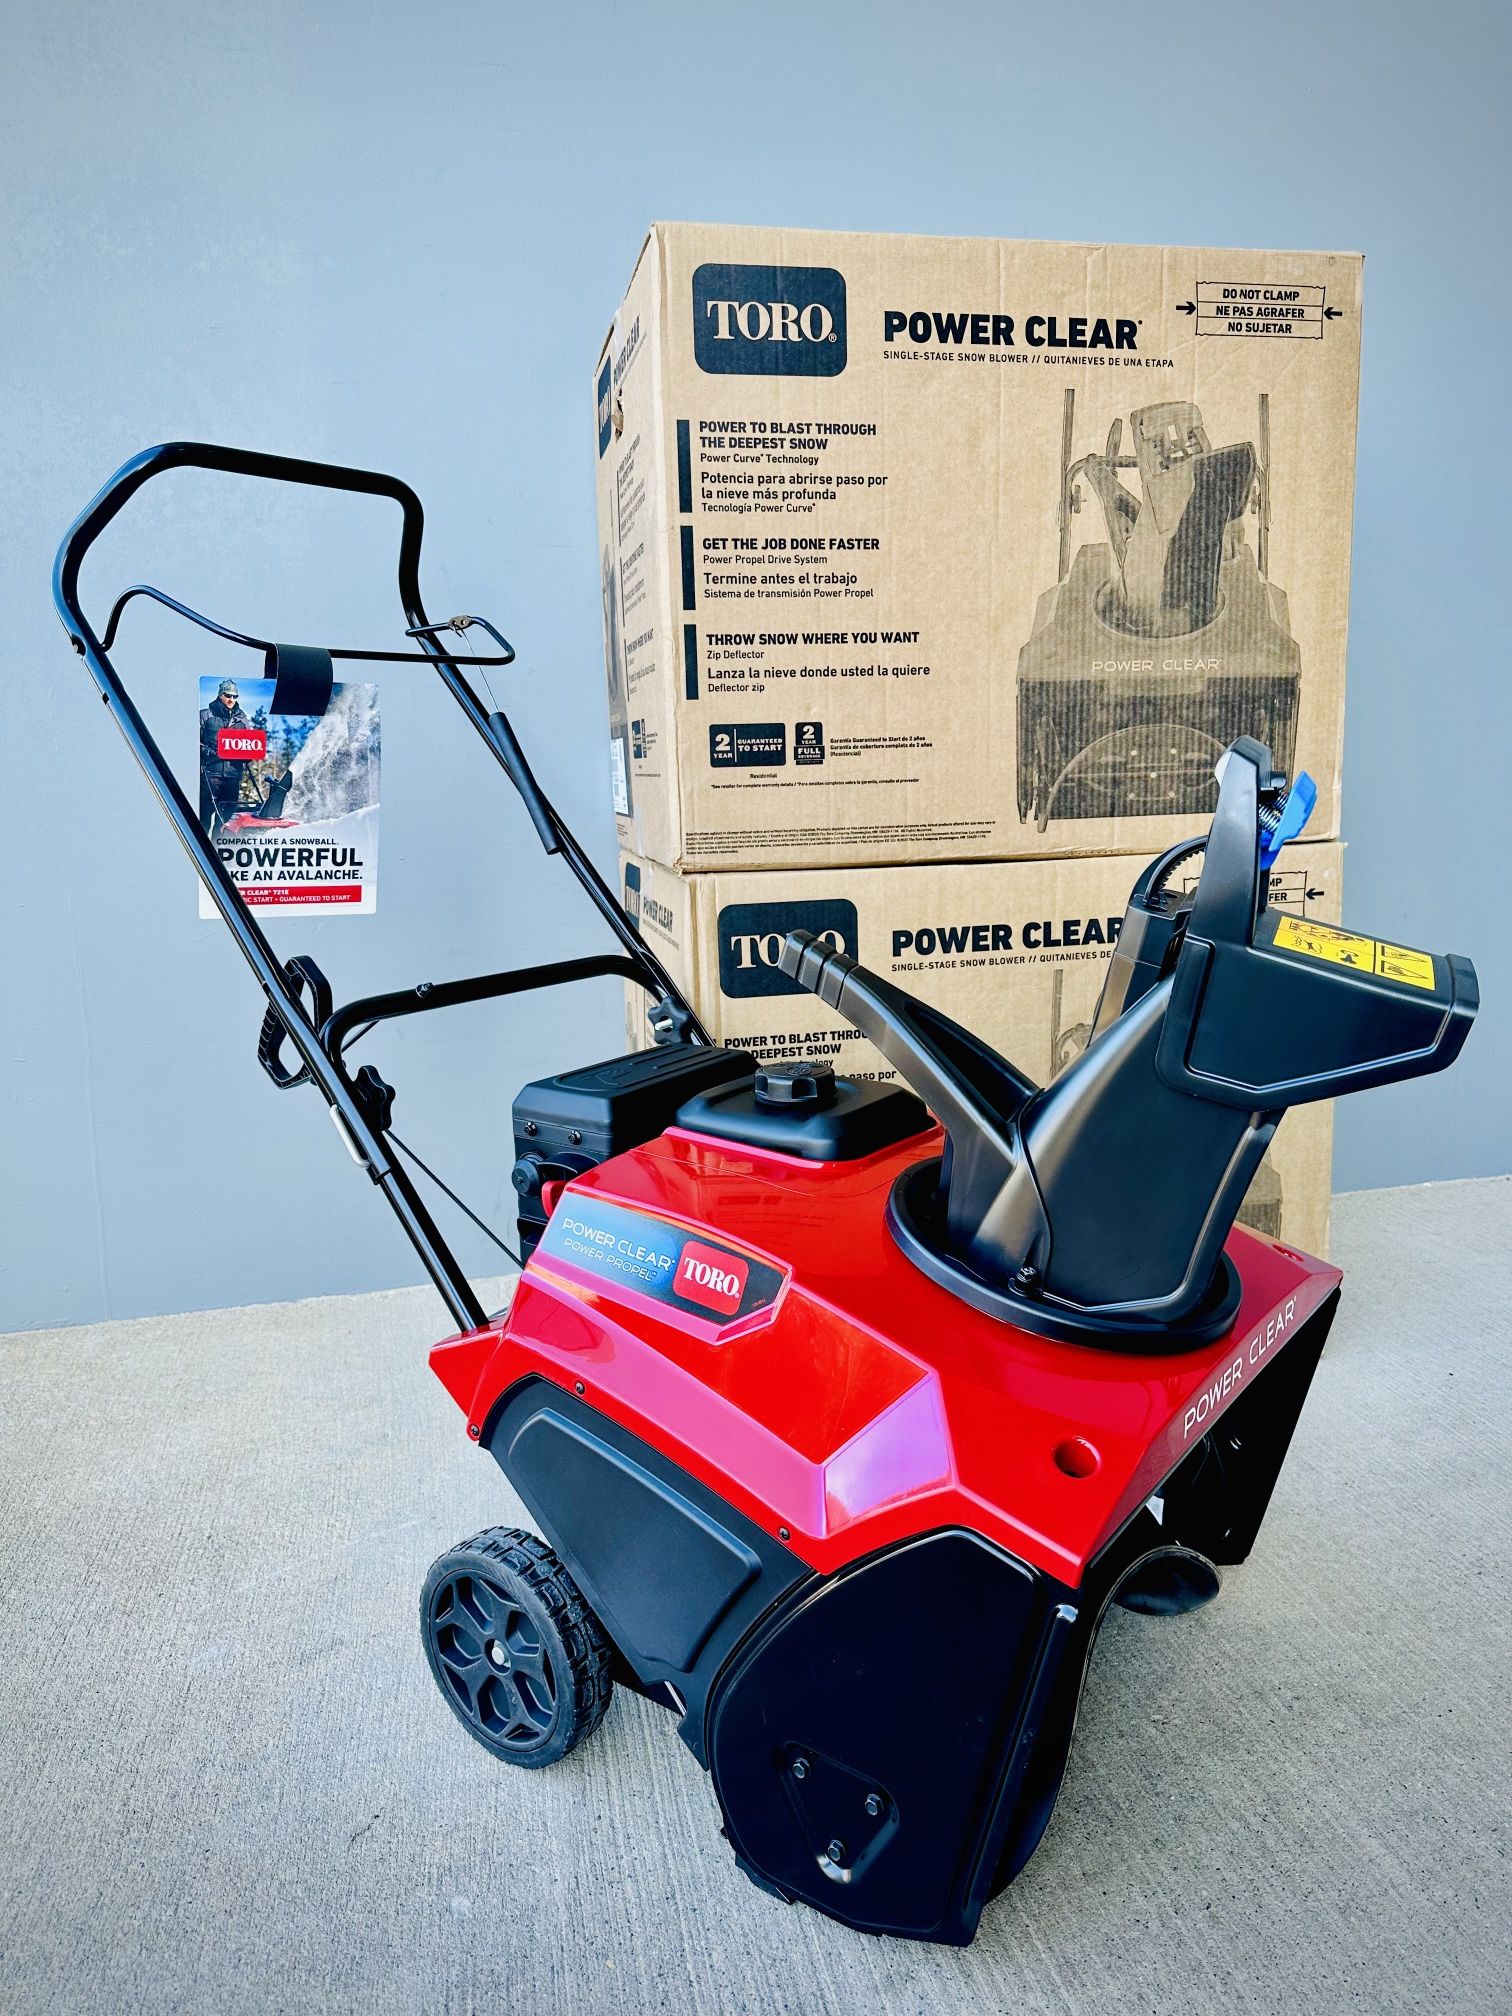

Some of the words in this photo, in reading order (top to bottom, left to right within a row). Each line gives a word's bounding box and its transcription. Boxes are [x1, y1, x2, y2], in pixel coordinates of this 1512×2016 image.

[1222, 288, 1237, 300] DO
[1239, 288, 1261, 301] NOT
[1263, 289, 1300, 302] CLAMP
[1216, 306, 1231, 317] NE
[1232, 306, 1253, 318] PAS
[1256, 306, 1305, 319] AGRAFER
[883, 310, 1015, 346] POWER
[1227, 321, 1242, 333] NO
[1244, 322, 1293, 334] SUJETAR
[883, 350, 953, 362] SINGLE-STAGE
[958, 353, 986, 363] SNOW
[989, 354, 1028, 364] BLOWER
[1043, 355, 1105, 367] QUITANIEVES
[1108, 357, 1120, 367] DE
[1123, 357, 1142, 367] UNA
[1145, 358, 1174, 368] ETAPA
[699, 420, 747, 433] POWER
[750, 421, 767, 433] TO
[770, 422, 812, 434] BLAST
[815, 423, 877, 436] THROUGH
[700, 437, 725, 448] THE
[729, 437, 786, 449] DEEPEST
[789, 438, 828, 449] SNOW
[700, 454, 731, 463] Power
[765, 454, 819, 466] Technology
[701, 472, 754, 484] Potencia
[757, 474, 785, 487] para
[788, 473, 833, 485] abrirse
[836, 475, 865, 488] paso
[867, 476, 888, 488] por
[701, 488, 713, 499] la
[716, 489, 749, 499] nieve
[752, 487, 778, 500] más
[782, 489, 836, 501] profunda
[702, 502, 752, 514] Tecnología
[754, 503, 784, 513] Power
[702, 538, 728, 550] GET
[731, 538, 758, 549] THE
[761, 538, 787, 549] JOB
[790, 538, 826, 550] DONE
[829, 538, 880, 550] FASTER
[703, 554, 733, 564] Power
[735, 554, 765, 566] Propel
[768, 554, 792, 564] Drive
[794, 555, 828, 566] System
[704, 572, 757, 584] Termine
[761, 573, 795, 584] antes
[798, 572, 810, 584] el
[813, 572, 858, 587] trabajo
[704, 589, 741, 598] Sistema
[744, 589, 755, 598] de
[757, 588, 811, 598] transmisión
[814, 588, 842, 598] Power
[845, 588, 874, 599] Propel
[707, 634, 755, 645] THROW
[758, 633, 798, 645] SNOW
[802, 633, 848, 644] WHERE
[851, 632, 878, 644] YOU
[881, 631, 920, 643] WANT
[707, 650, 721, 660] Zip
[723, 650, 765, 659] Deflector
[707, 667, 745, 679] Lanza
[749, 667, 761, 678] la
[764, 666, 797, 678] nieve
[800, 666, 837, 677] donde
[841, 665, 875, 677] usted
[878, 664, 889, 676] la
[892, 665, 931, 678] quiere
[1092, 660, 1154, 673] POWER
[708, 683, 749, 692] Deflector
[752, 683, 765, 693] zip
[803, 725, 815, 739] 2
[715, 733, 731, 751] 2
[752, 744, 783, 752] START
[217, 847, 363, 868] POWERFUL
[253, 870, 272, 881] AN
[277, 869, 363, 880] AVALANCHE.
[892, 924, 1012, 957] POWER
[1022, 917, 1123, 949] CLEAR
[730, 930, 846, 968] TOO
[891, 961, 957, 972] SINGLE-STAGE
[960, 959, 986, 968] SNOW
[988, 956, 1025, 967] BLOWER
[1040, 951, 1097, 962] QUITANIEVES
[1100, 951, 1111, 959] DE
[724, 1036, 768, 1048] POWER
[770, 1035, 786, 1045] TO
[789, 1032, 827, 1044] BLAST
[830, 1029, 868, 1041] THRO
[751, 1047, 803, 1059] DEEPEST
[806, 1043, 842, 1056] SNOW
[878, 1071, 897, 1082] por
[562, 1218, 616, 1249] POWER
[563, 1238, 604, 1262] POWER
[1183, 1357, 1243, 1439] POWER
